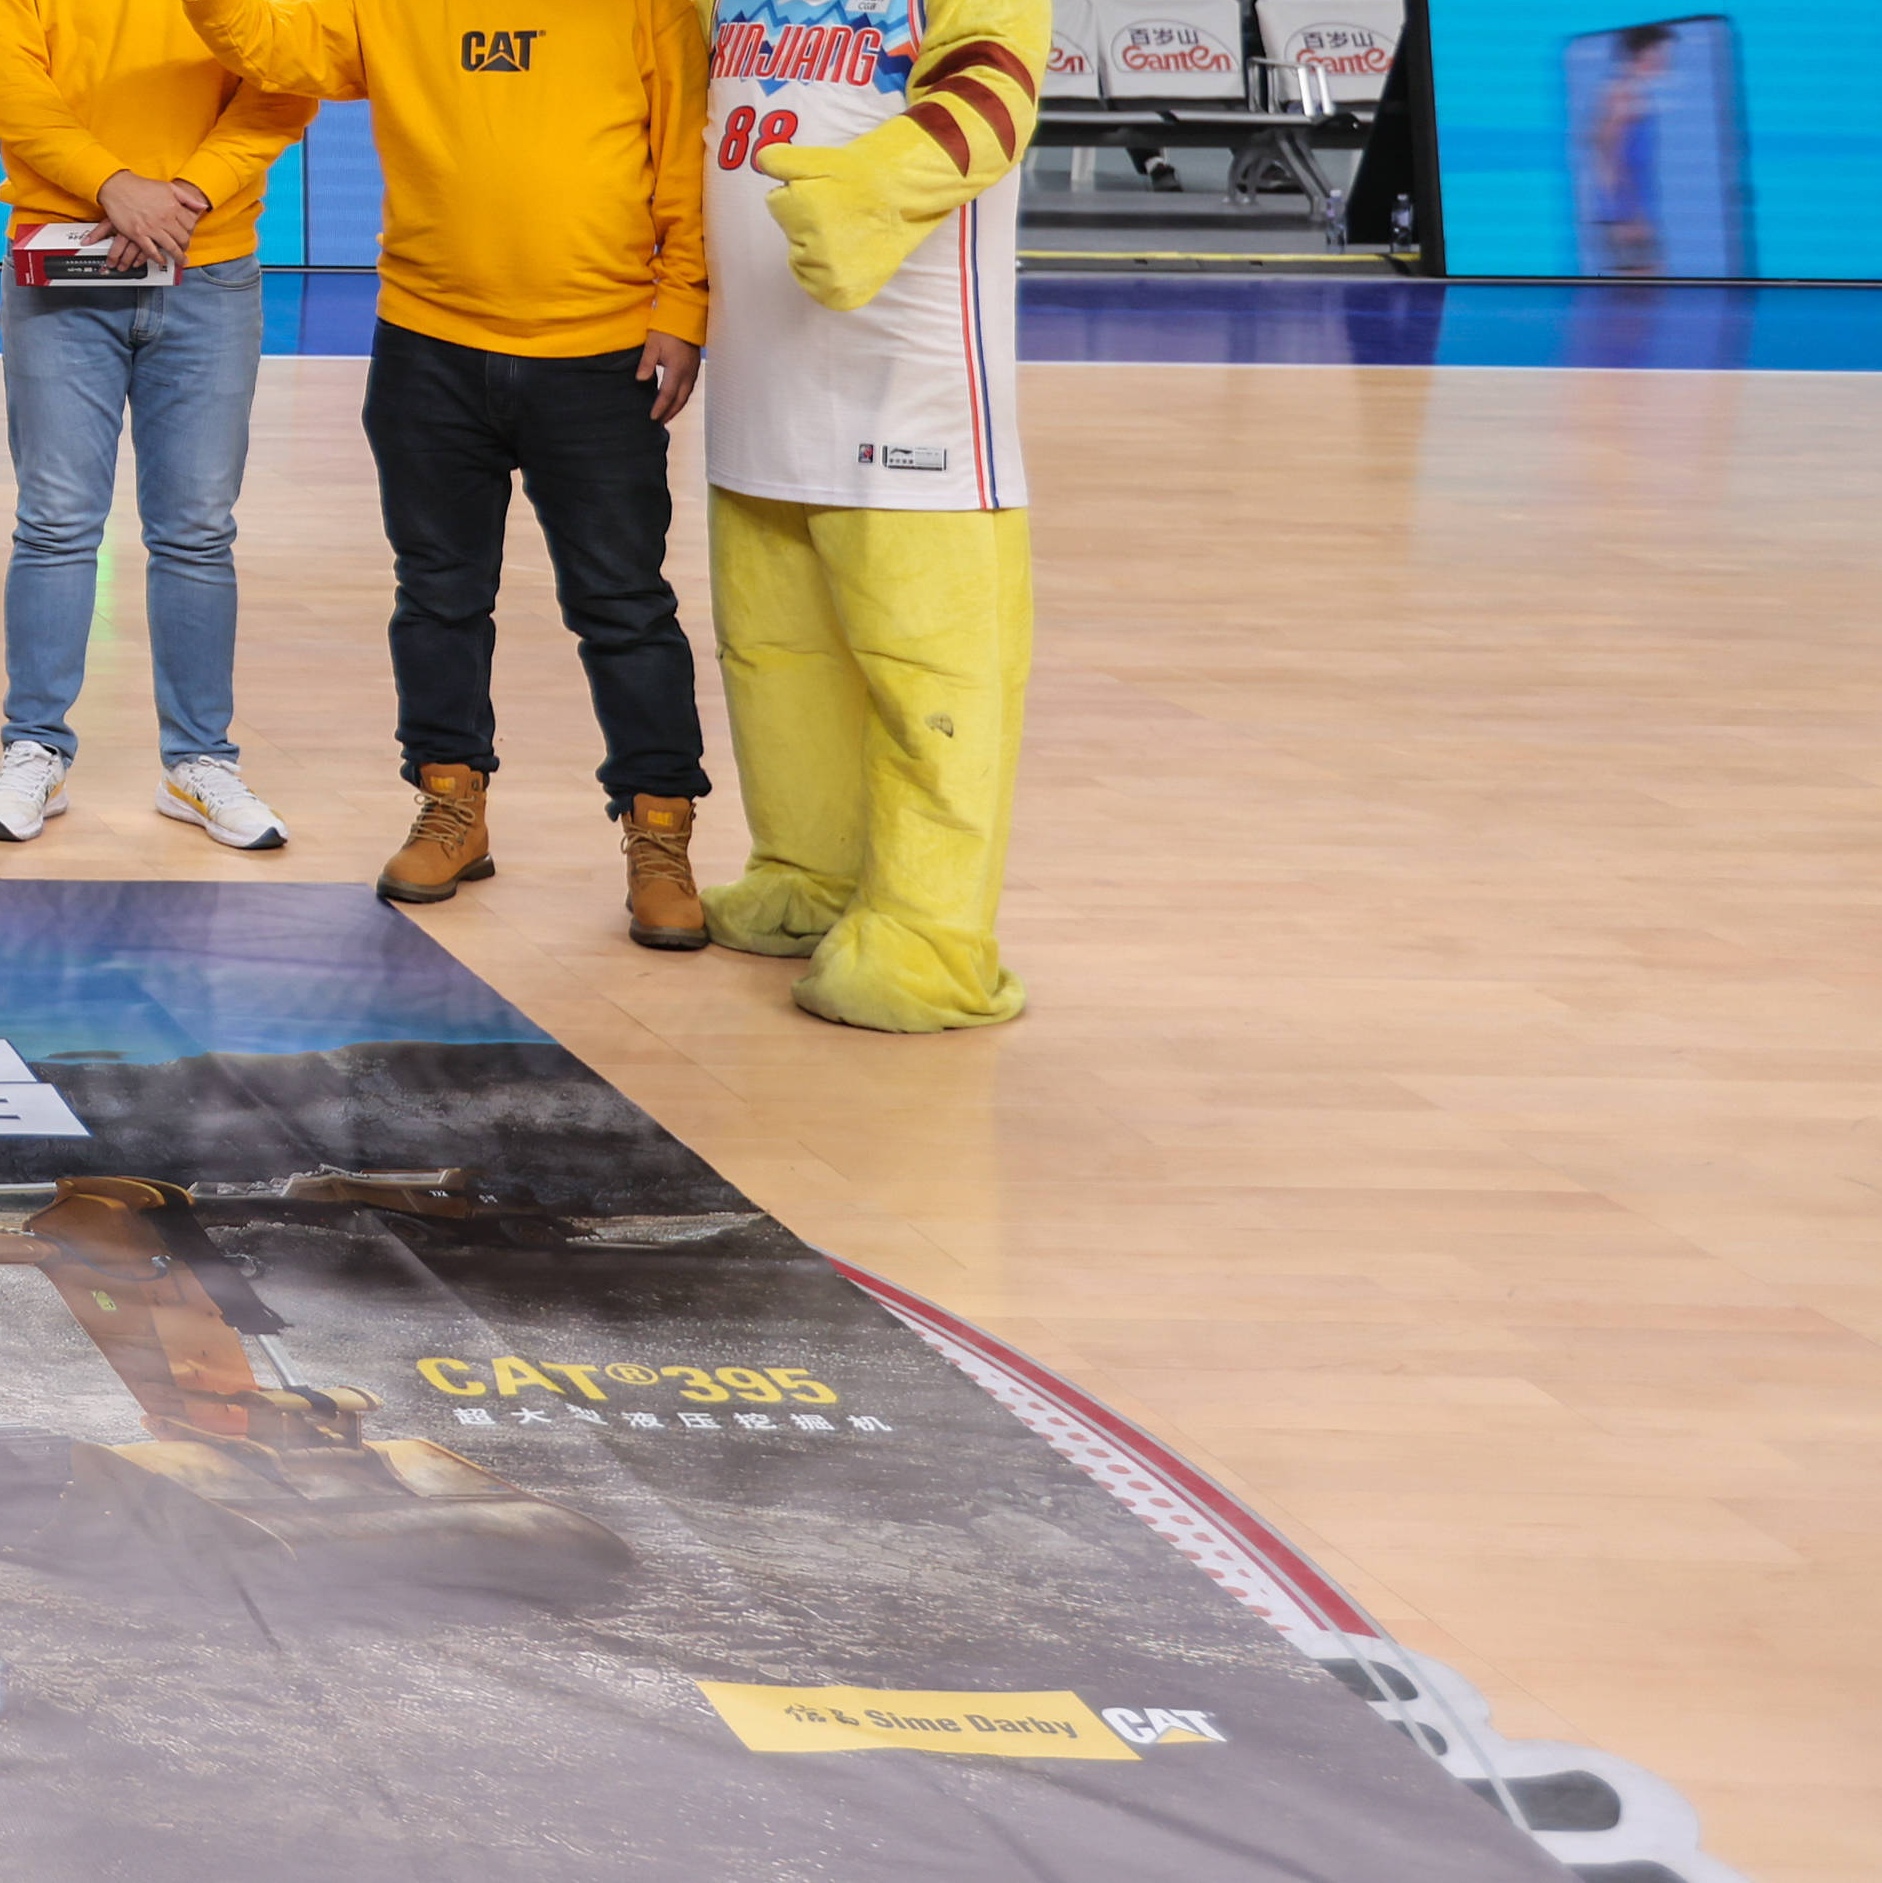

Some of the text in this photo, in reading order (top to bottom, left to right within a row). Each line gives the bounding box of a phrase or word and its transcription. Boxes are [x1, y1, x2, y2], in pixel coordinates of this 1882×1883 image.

[461, 30, 537, 72] CAT
[1131, 29, 1199, 46] 百岁山
[1305, 32, 1374, 49] 百岁山
[712, 23, 882, 86] XINJIANG
[453, 1402, 892, 1433] 超大型液压挖掘机
[863, 1708, 962, 1733] Sime
[964, 1714, 1078, 1739] Darby
[1101, 1707, 1228, 1745] CAT
